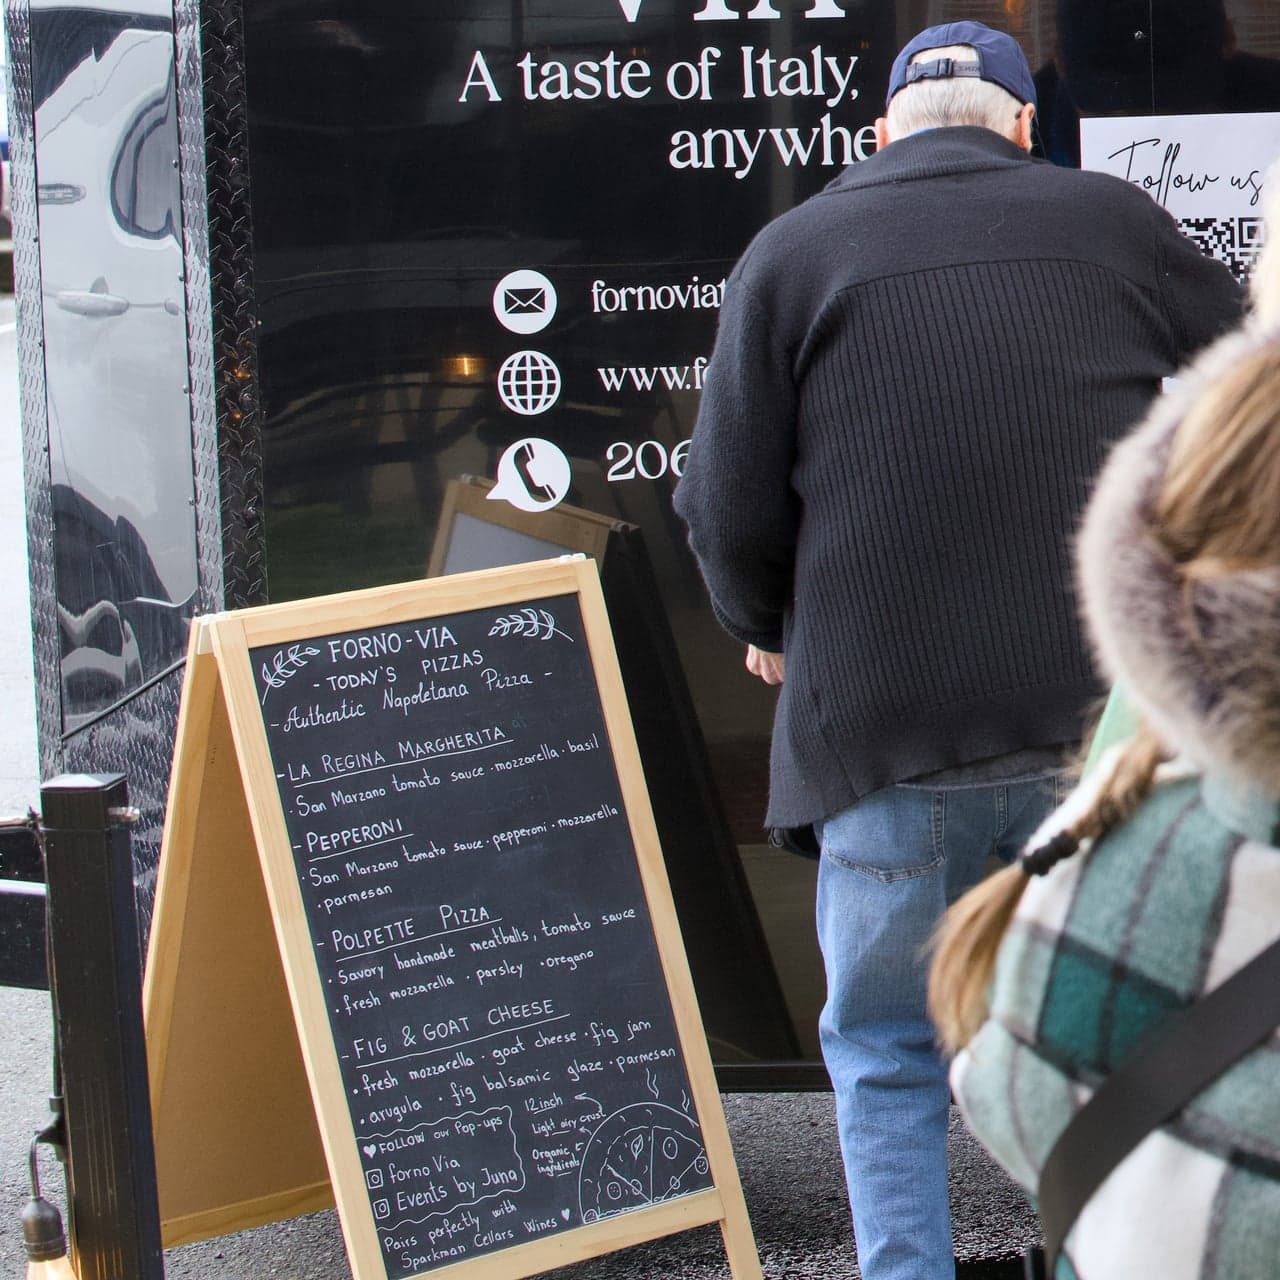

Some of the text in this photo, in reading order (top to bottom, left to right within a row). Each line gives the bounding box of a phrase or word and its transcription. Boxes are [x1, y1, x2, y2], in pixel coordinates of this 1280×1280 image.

[459, 45, 860, 108] A taste of Italy,
[669, 113, 878, 179] anywhe
[1108, 138, 1264, 207] Follow us
[326, 649, 483, 691] TODAY'S PIZZAS
[283, 668, 533, 732] Authentic Napoletana Pizza
[288, 726, 505, 782] LA REGINA MARGHERITA
[296, 733, 599, 817] San Marzano tomato sauce mozzarella basil
[306, 818, 403, 853] PEPPERONI
[309, 804, 618, 887] San Marzano tomato sauce pepperoni mozzarella
[323, 885, 393, 915] parmesan
[331, 904, 490, 952] POLPETTE PIZZA
[338, 965, 385, 985] Savory
[394, 943, 456, 970] handmade
[541, 913, 591, 937] tomato
[602, 908, 636, 925] sauce
[343, 950, 594, 1016] fresh mozzarella parsley oregano
[353, 999, 555, 1059] FIG & GOAT CHEESE
[362, 1020, 652, 1096] fresh mozzarella goat cheese fig jam
[369, 1047, 676, 1122] arugula fig balsamic glaze parmesan
[379, 1116, 503, 1154] FOLLOW our Pop-ups
[532, 1111, 606, 1136] Light airy crust
[432, 1155, 460, 1173] Via
[532, 1144, 570, 1163] Organic
[397, 1167, 518, 1211] Events by Juna
[384, 1199, 517, 1253] Pairs perfectly with
[401, 1217, 557, 1271] Sparkman Cellars Wines
